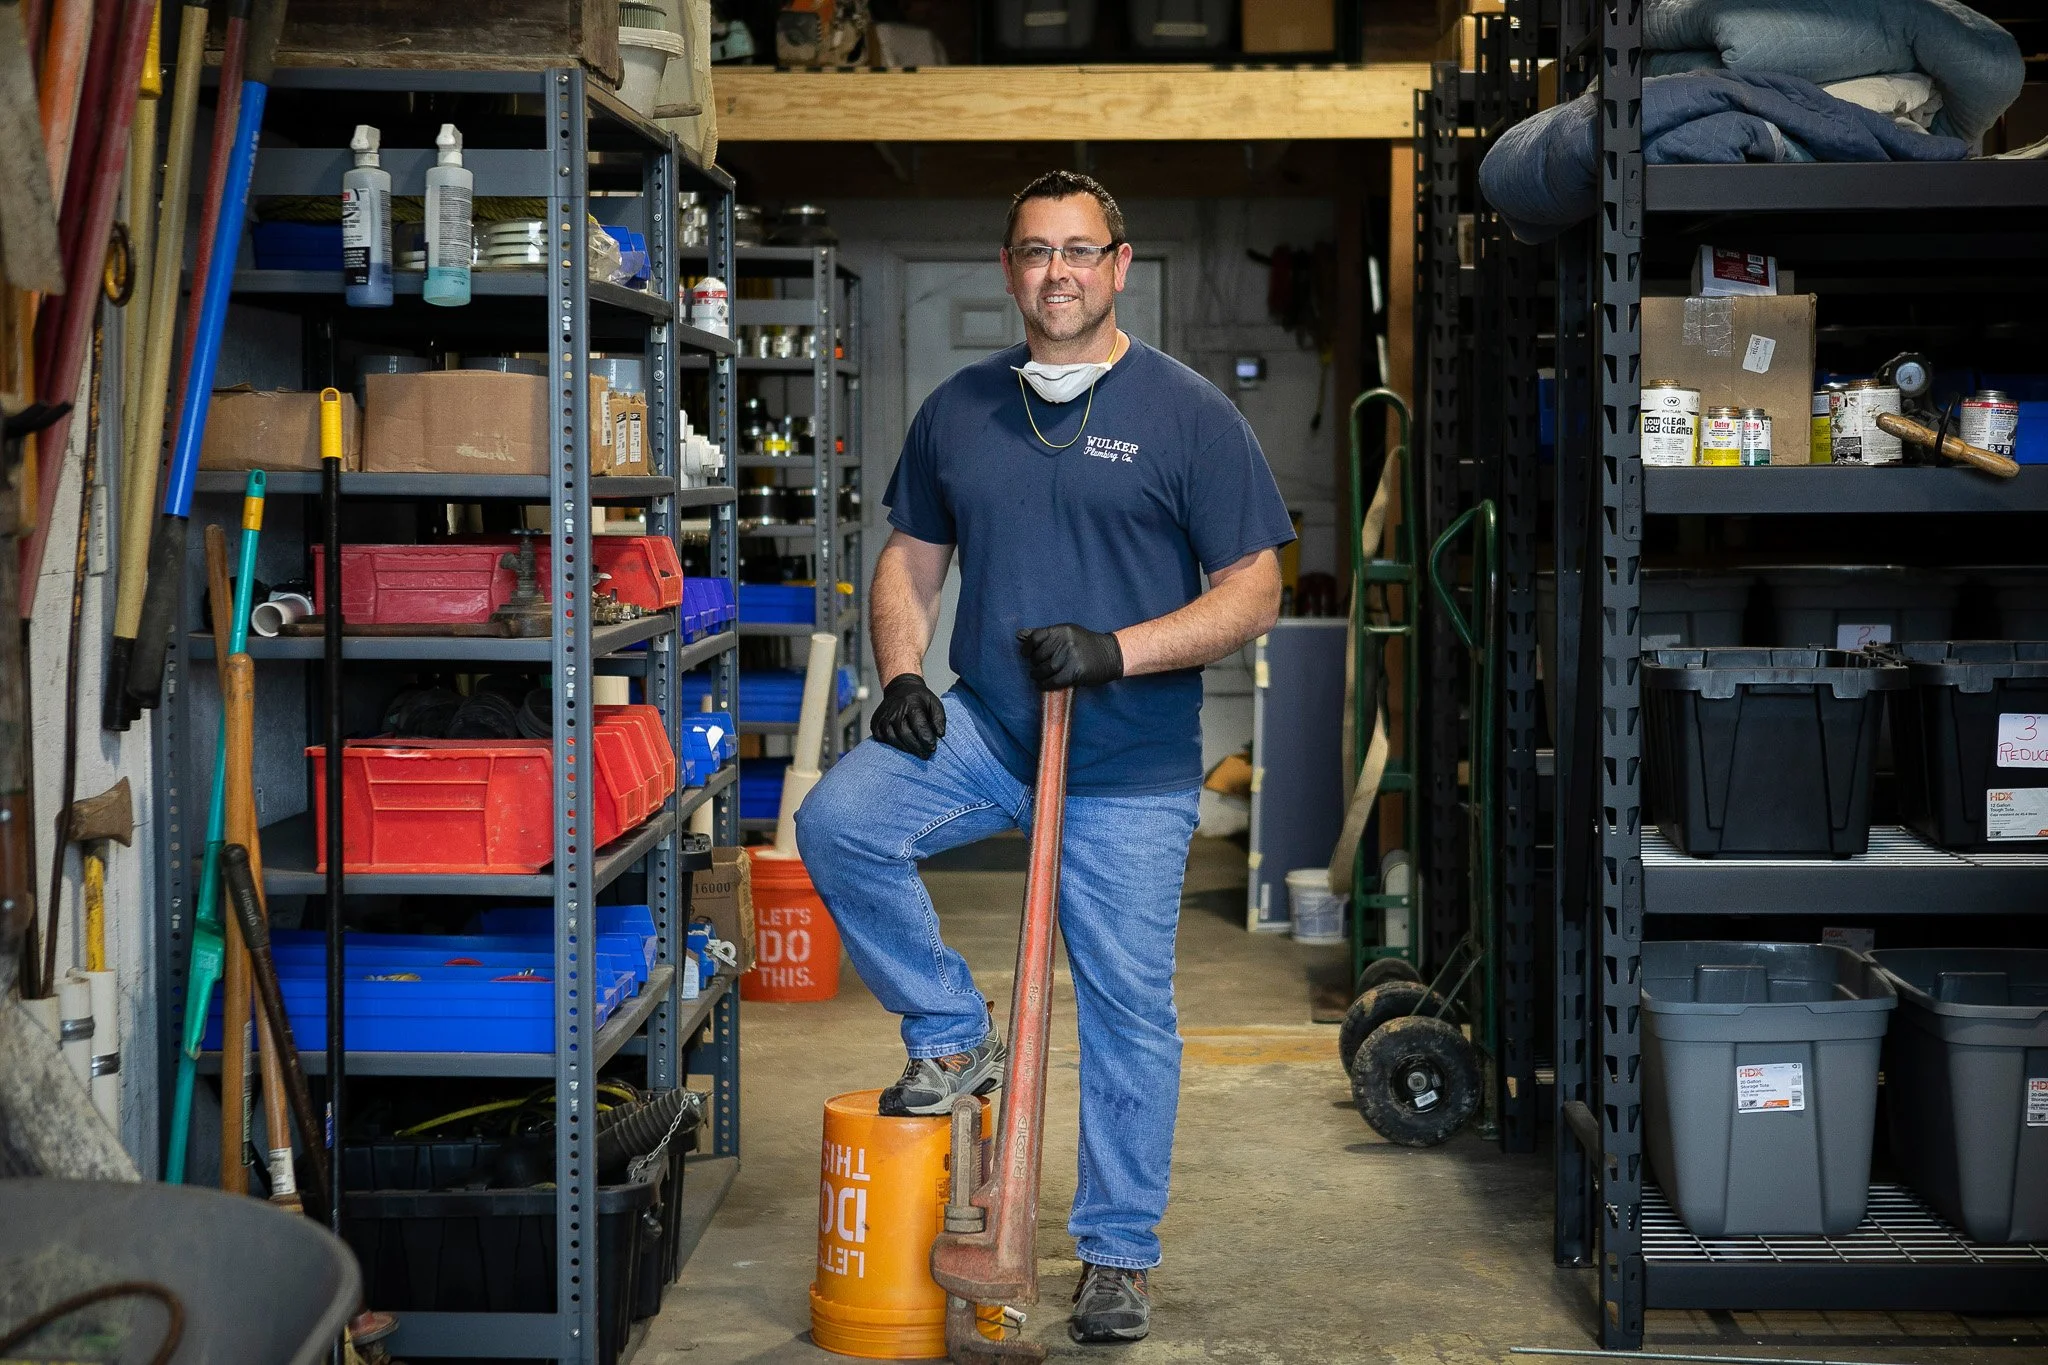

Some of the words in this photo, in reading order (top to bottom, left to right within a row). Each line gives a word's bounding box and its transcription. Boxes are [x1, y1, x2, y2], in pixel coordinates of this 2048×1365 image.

[1662, 417, 1686, 426] CLEAR
[1662, 426, 1693, 435] CLEANER
[1087, 436, 1139, 454] WULKER
[1084, 446, 1119, 462] Plumbing
[1990, 792, 2014, 801] HDX
[694, 881, 731, 895] 16000
[758, 907, 812, 926] LET'S
[759, 929, 811, 964] DO
[759, 966, 816, 988] THIS.
[1740, 1067, 1764, 1078] HDX
[2031, 1081, 2048, 1090] HD
[1013, 1115, 1028, 1179] RIDGID
[820, 1179, 867, 1244] DO
